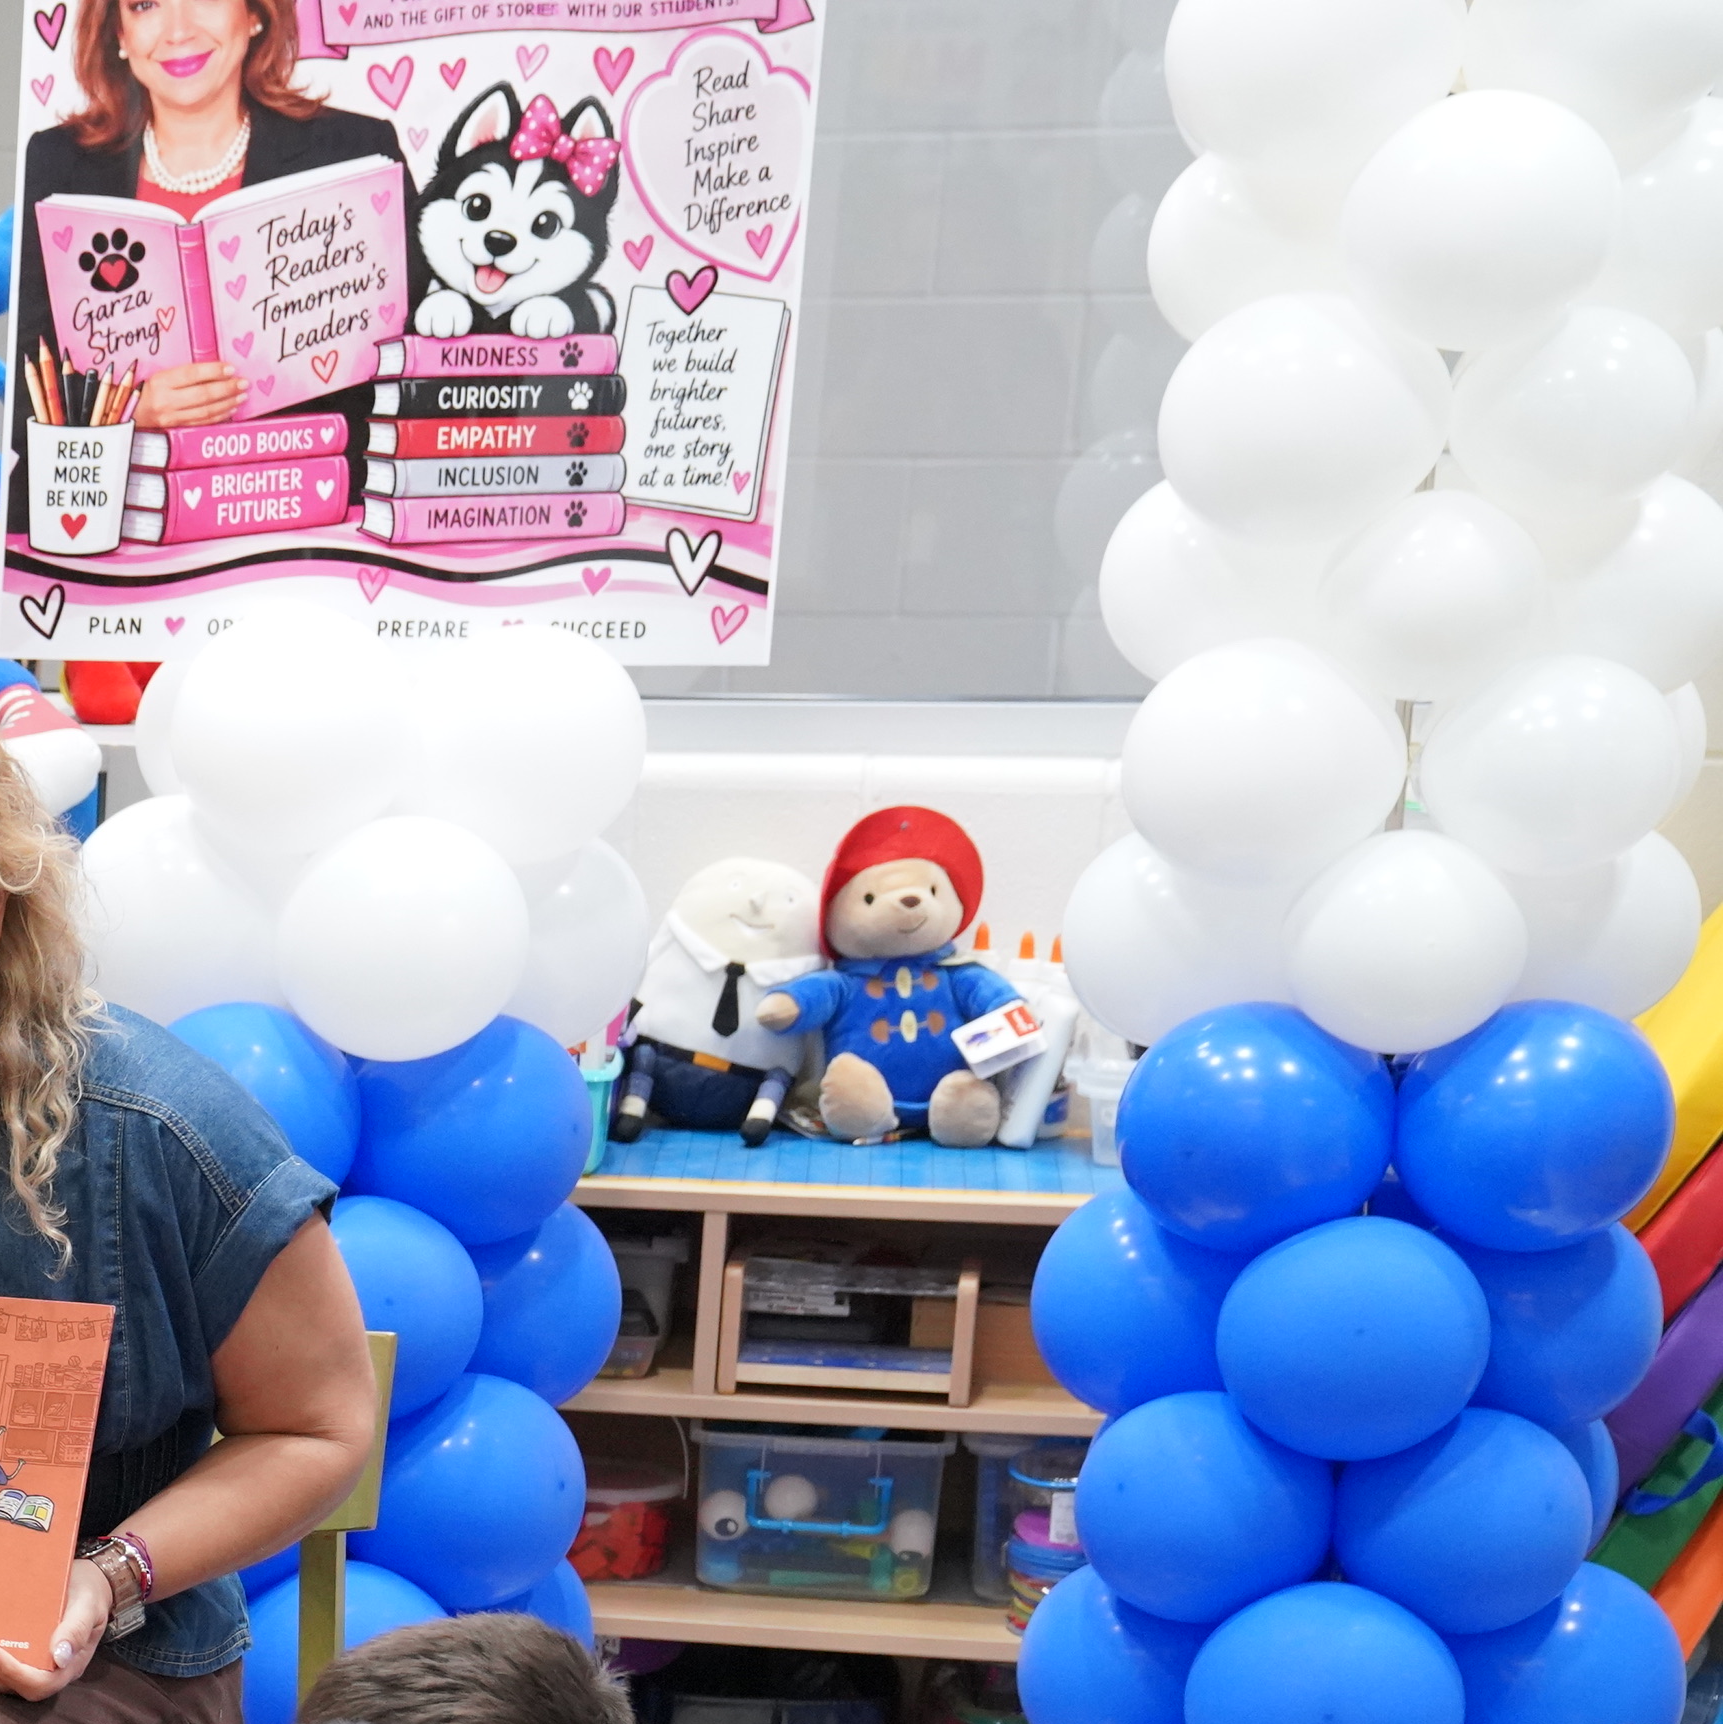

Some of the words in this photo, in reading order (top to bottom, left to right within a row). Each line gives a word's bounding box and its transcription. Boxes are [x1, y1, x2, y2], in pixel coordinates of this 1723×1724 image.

[363, 14, 394, 30] AND
[401, 12, 427, 26] THE
[434, 8, 464, 23] GIFT
[472, 5, 489, 19] OF
[567, 4, 605, 17] WITH
[612, 4, 642, 17] OUR
[692, 61, 750, 99] Read
[691, 102, 757, 133] Share
[684, 132, 760, 171] Inspire
[692, 165, 751, 198] Make
[758, 166, 773, 184] a
[684, 193, 791, 235] Difference
[257, 202, 356, 256] Today's
[265, 238, 368, 292] Readers
[252, 262, 389, 332] Tomorrow's
[72, 287, 153, 338] Garza
[86, 318, 161, 365] Strong
[276, 306, 372, 363] Leaders
[647, 319, 728, 348] Together
[441, 346, 540, 368] KINDNESS
[652, 357, 677, 374] we
[684, 349, 737, 374] build
[437, 385, 543, 411] CURIOSITY
[650, 377, 728, 411] brighter
[436, 425, 537, 451] EMPATHY
[649, 409, 728, 438] futures,
[57, 440, 104, 460] READ
[201, 433, 252, 459] GOOD
[256, 427, 314, 453] BOOKS
[643, 444, 675, 458] one
[683, 439, 734, 466] story
[54, 465, 101, 484] MORE
[210, 468, 304, 499] BRIGHTER
[437, 465, 540, 488] INCLUSION
[638, 471, 657, 488] at
[663, 474, 676, 488] a
[682, 460, 735, 488] time!
[46, 490, 69, 507] BE
[71, 489, 108, 507] KIND
[216, 496, 303, 526] FUTURES
[427, 504, 551, 530] IMAGINATION
[88, 616, 143, 635] PLAN
[377, 619, 470, 640] PREPARE
[551, 621, 647, 639] CCEED
[0, 1637, 30, 1650] serres
